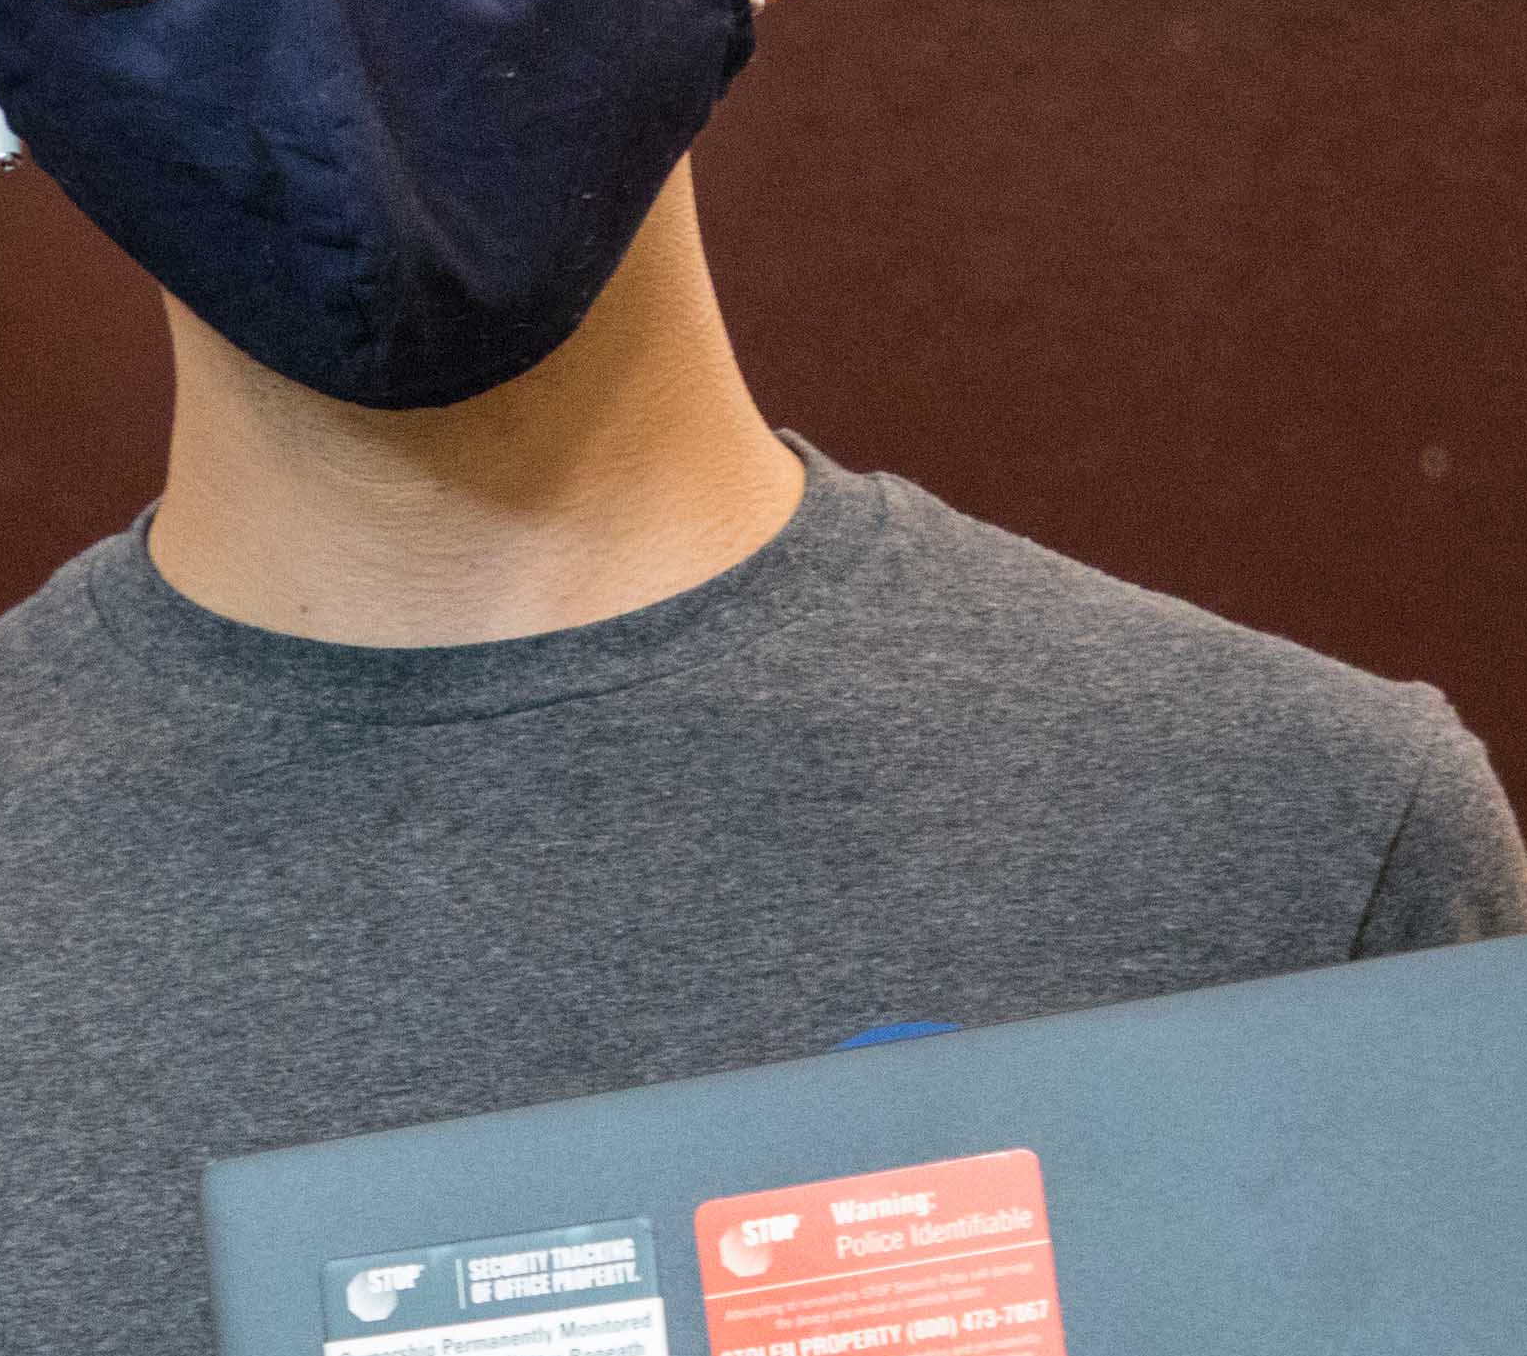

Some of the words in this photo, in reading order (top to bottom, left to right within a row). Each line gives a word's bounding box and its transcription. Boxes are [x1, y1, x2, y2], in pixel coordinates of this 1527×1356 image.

[740, 1214, 801, 1246] STOP
[829, 1191, 937, 1226] Warning:
[836, 1230, 905, 1259] Police
[909, 1207, 1034, 1246] Identifiable
[368, 1264, 424, 1293] STOP
[468, 1250, 549, 1281] SECURITY
[549, 1238, 636, 1270] TRACKING
[470, 1280, 493, 1304] OF
[493, 1273, 551, 1301] OFFICE
[441, 1326, 553, 1355] Permanently
[558, 1312, 652, 1339] Monitored
[905, 1314, 959, 1344] (800)
[961, 1299, 1050, 1331] 473-7867
